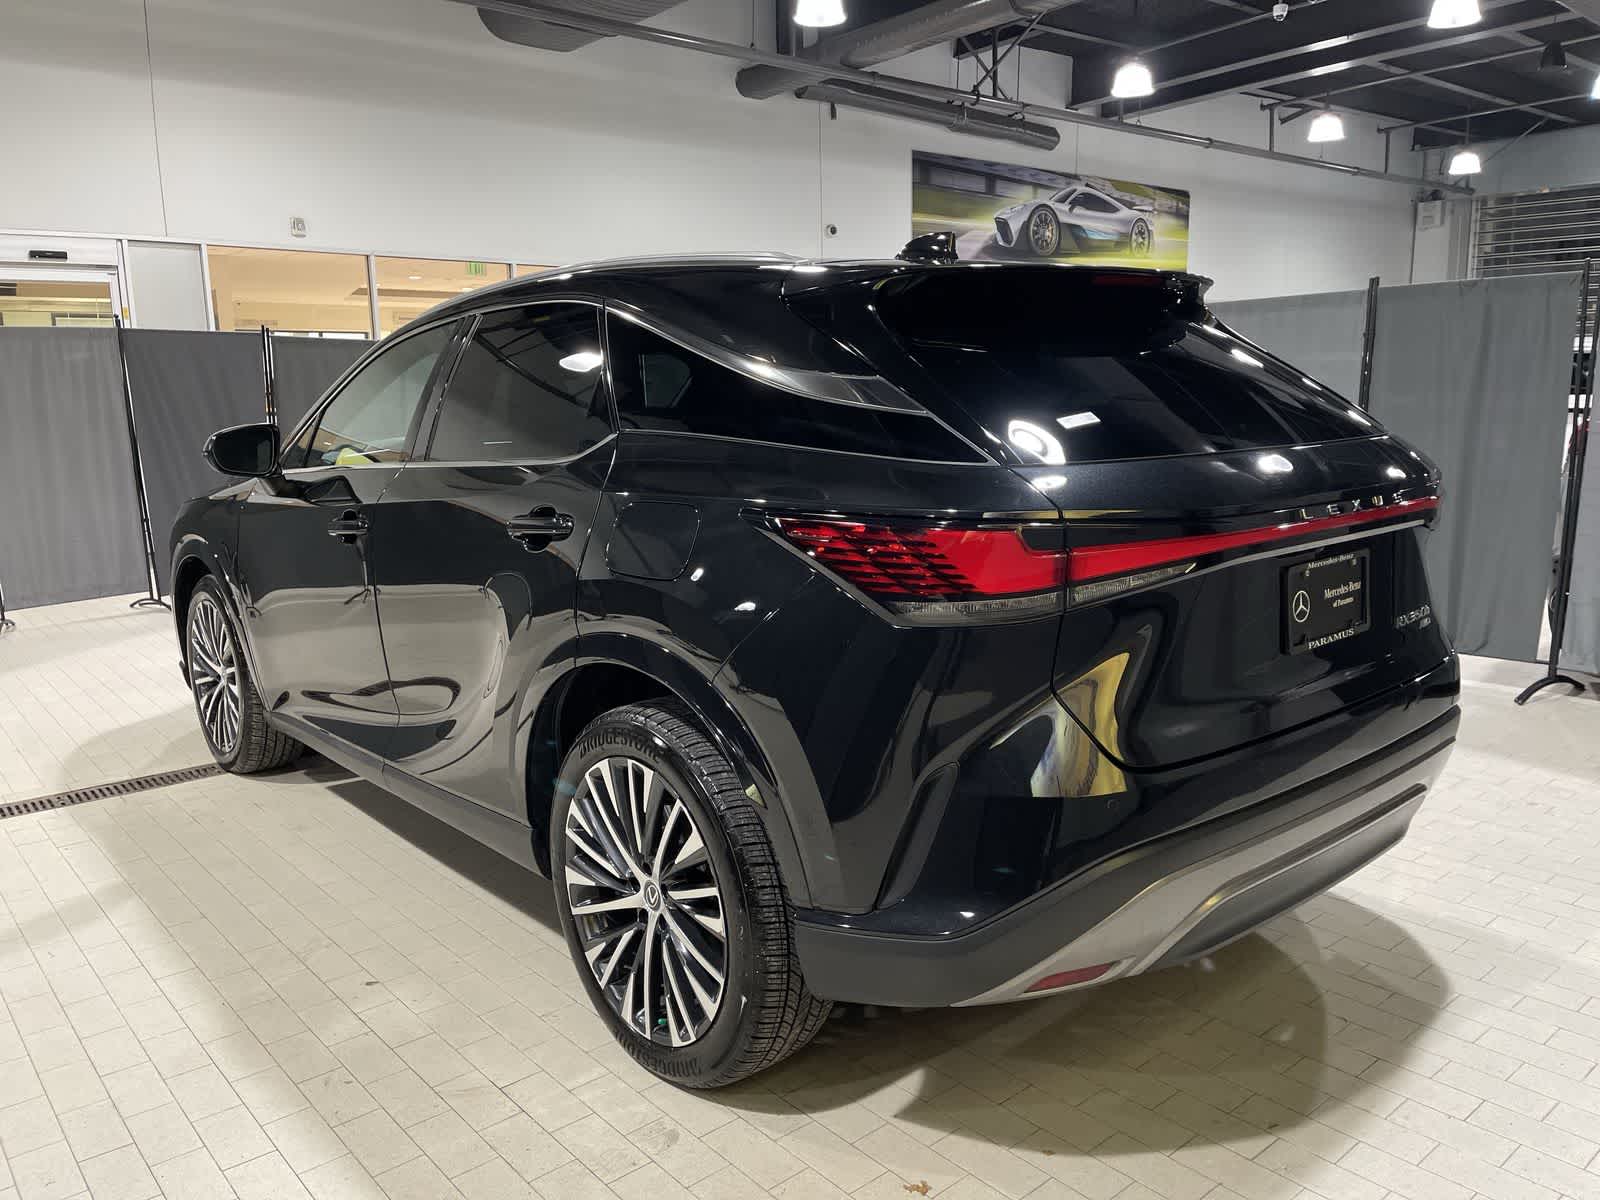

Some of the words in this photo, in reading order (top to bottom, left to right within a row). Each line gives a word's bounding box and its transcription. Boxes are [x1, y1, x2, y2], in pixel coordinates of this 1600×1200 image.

[1300, 490, 1404, 519] LEXUS
[1307, 553, 1354, 569] Mercedes-Benz
[1324, 581, 1361, 599] Mercedes-Benz
[1308, 628, 1354, 649] PARAMUS
